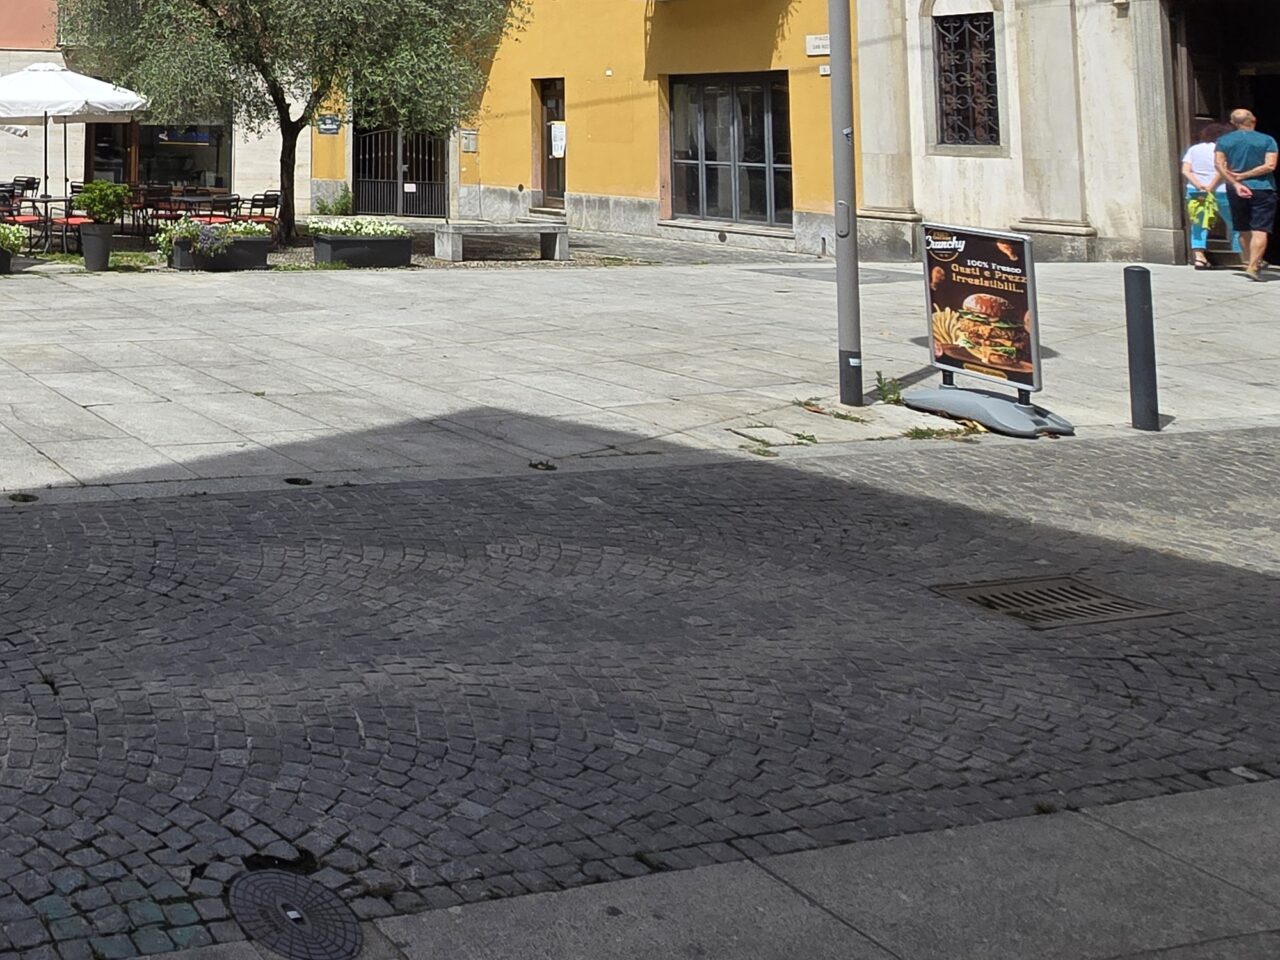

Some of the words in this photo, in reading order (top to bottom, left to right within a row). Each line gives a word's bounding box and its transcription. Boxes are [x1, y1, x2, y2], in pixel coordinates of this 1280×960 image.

[951, 263, 980, 276] Gusti
[967, 259, 989, 269] 100%
[991, 263, 1022, 274] Fresco
